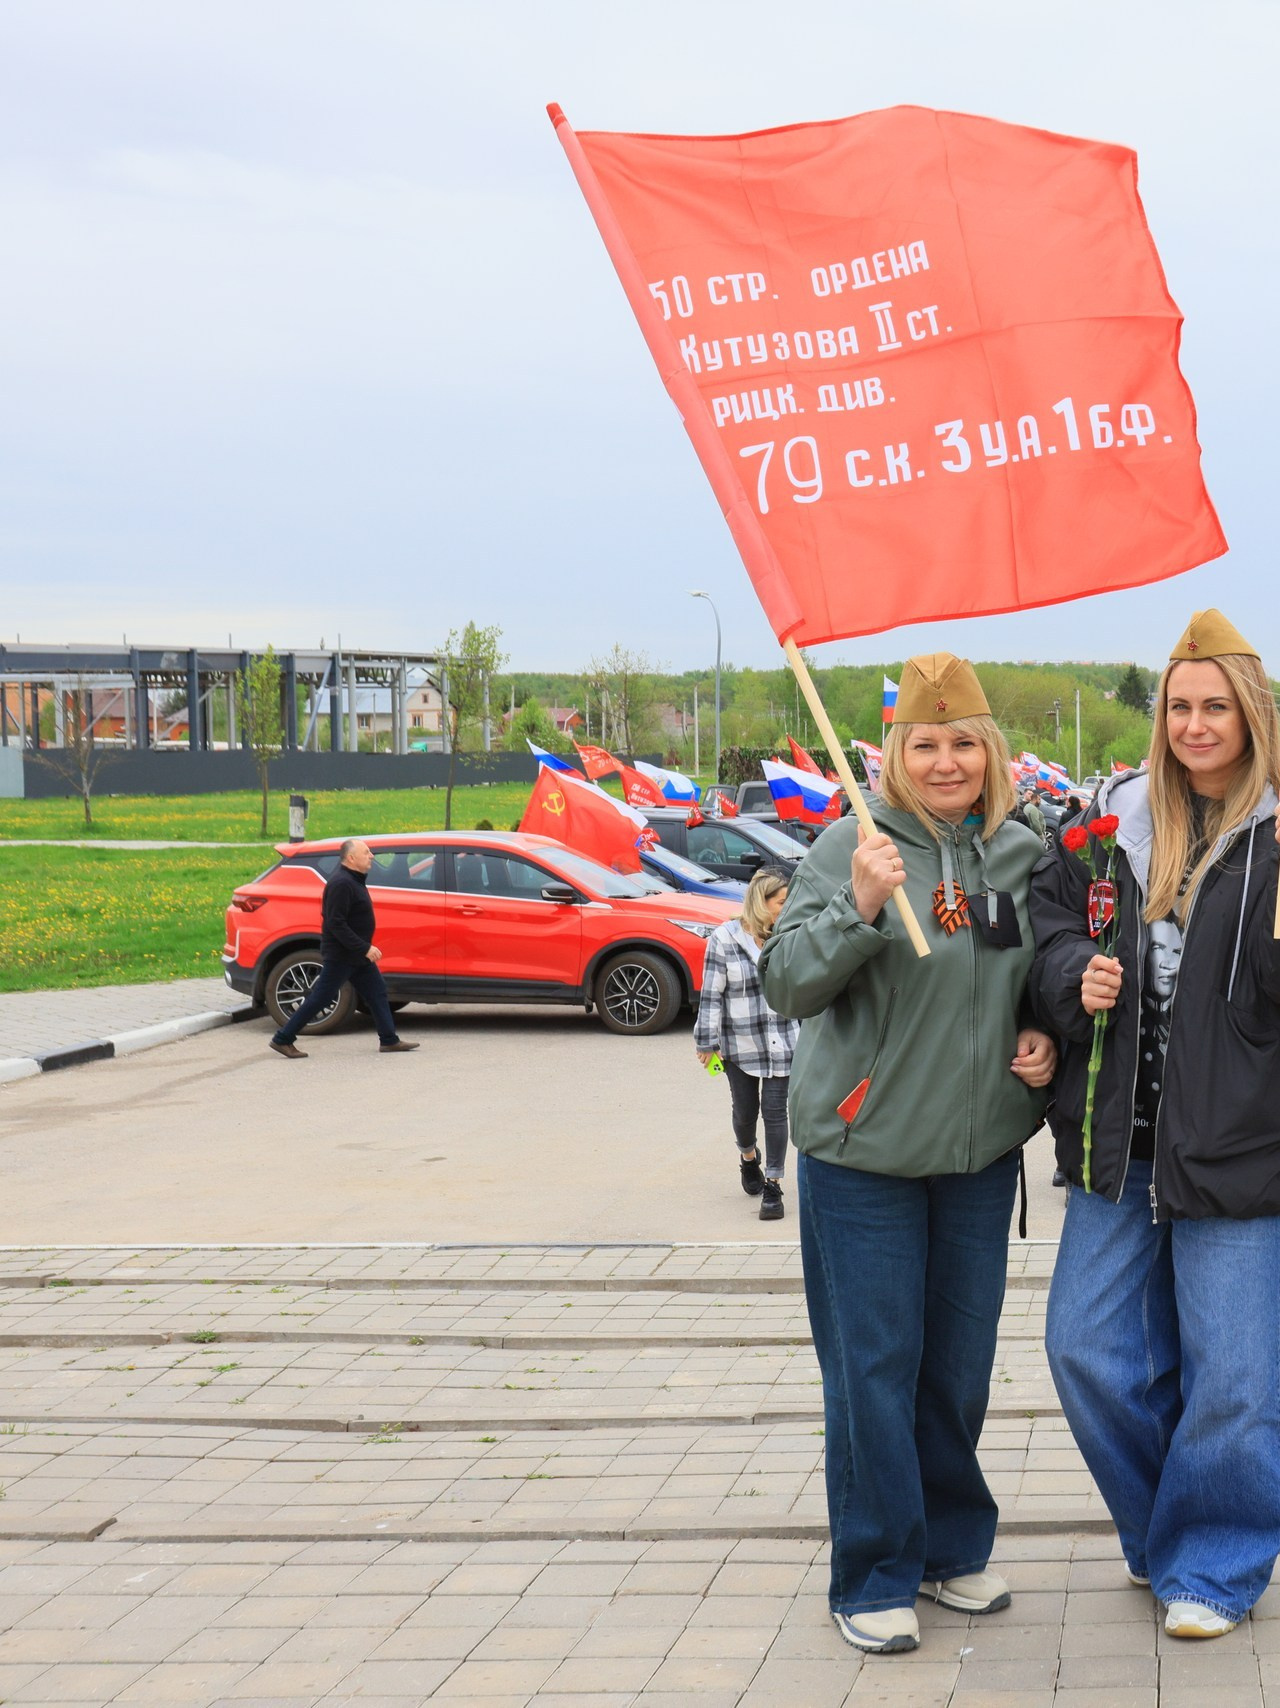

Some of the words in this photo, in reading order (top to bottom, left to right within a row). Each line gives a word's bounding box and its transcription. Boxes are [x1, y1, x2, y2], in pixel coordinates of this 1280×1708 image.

[707, 272, 779, 305] СТР.
[810, 240, 930, 297] ОРДЕНА
[868, 301, 903, 353] II
[906, 304, 953, 341] СТ.
[711, 383, 805, 428] РИЦК.
[816, 376, 896, 413] ДИВ.
[739, 435, 823, 515] 79
[845, 442, 926, 488] С.К.
[934, 418, 972, 473] 3
